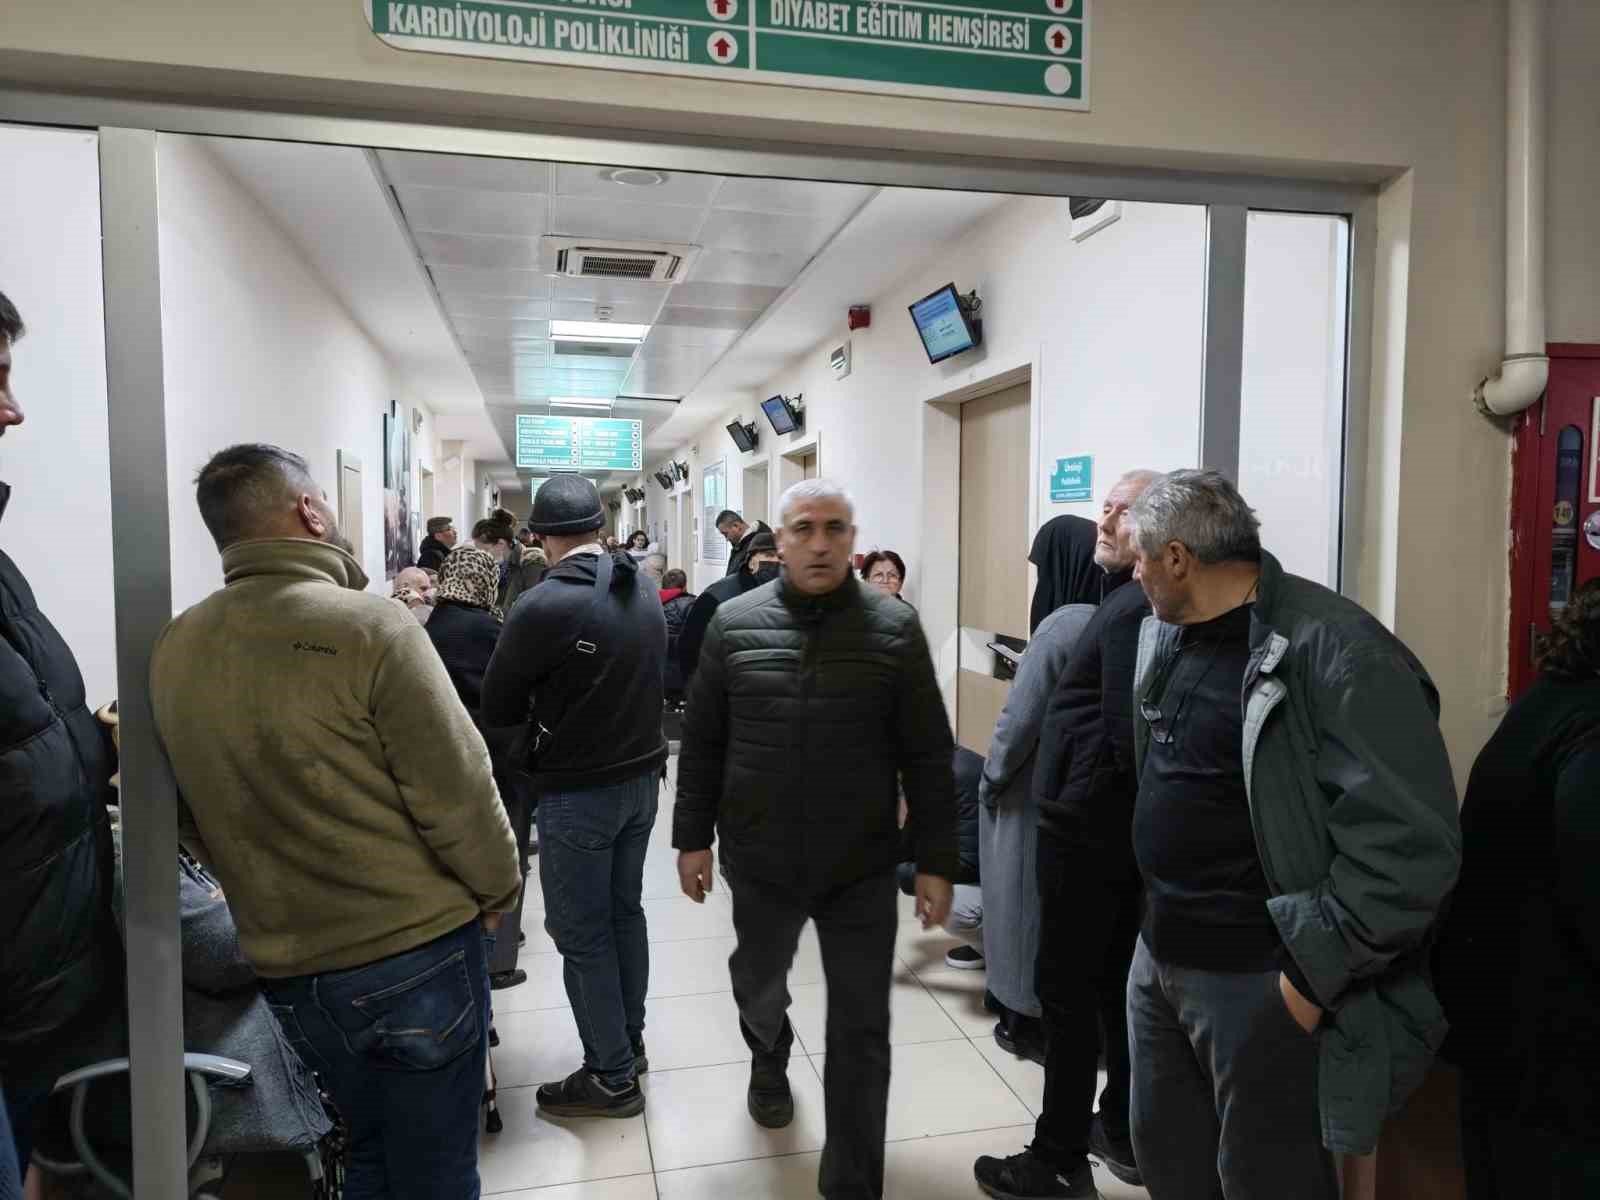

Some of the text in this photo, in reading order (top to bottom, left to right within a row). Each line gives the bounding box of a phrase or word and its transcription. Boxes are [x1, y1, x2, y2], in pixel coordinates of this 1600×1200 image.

[387, 3, 689, 61] KARDİYOLOJİ POLİKLİNİĞİ
[856, 0, 922, 40] EĞİTİM
[928, 12, 1030, 51] HEMŞİRESİ
